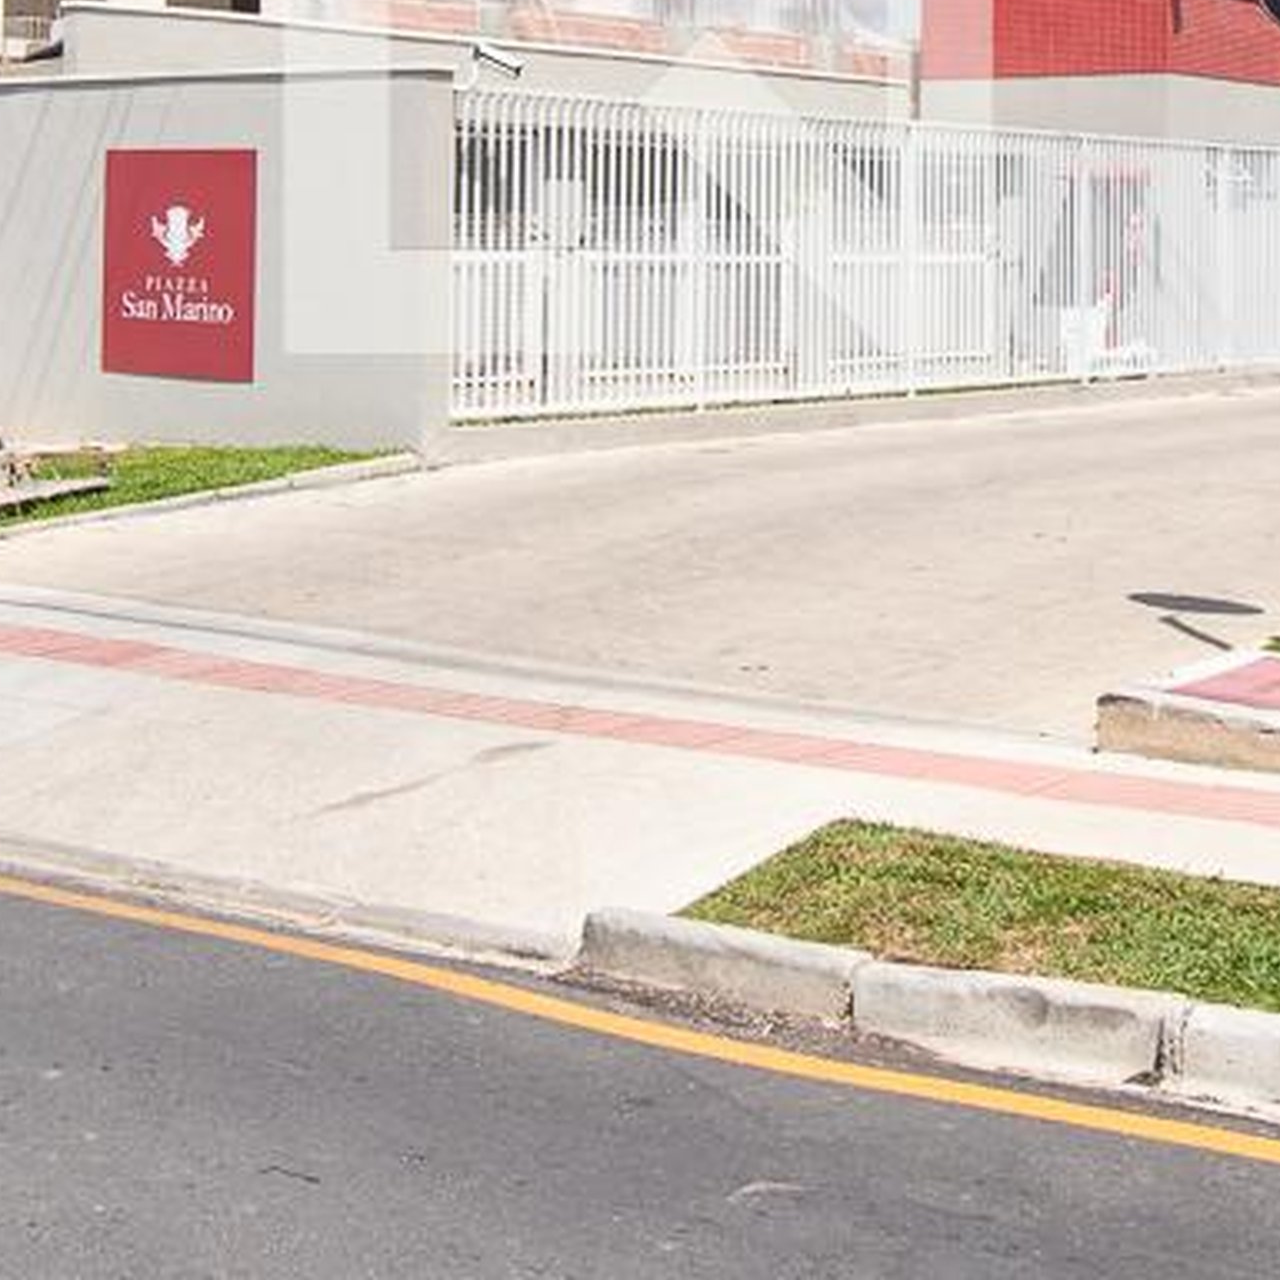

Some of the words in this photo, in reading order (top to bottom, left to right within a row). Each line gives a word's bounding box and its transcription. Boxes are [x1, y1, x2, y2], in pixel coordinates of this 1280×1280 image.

[145, 275, 208, 293] PIAZZA
[122, 290, 158, 319] San
[161, 292, 235, 324] Marino
